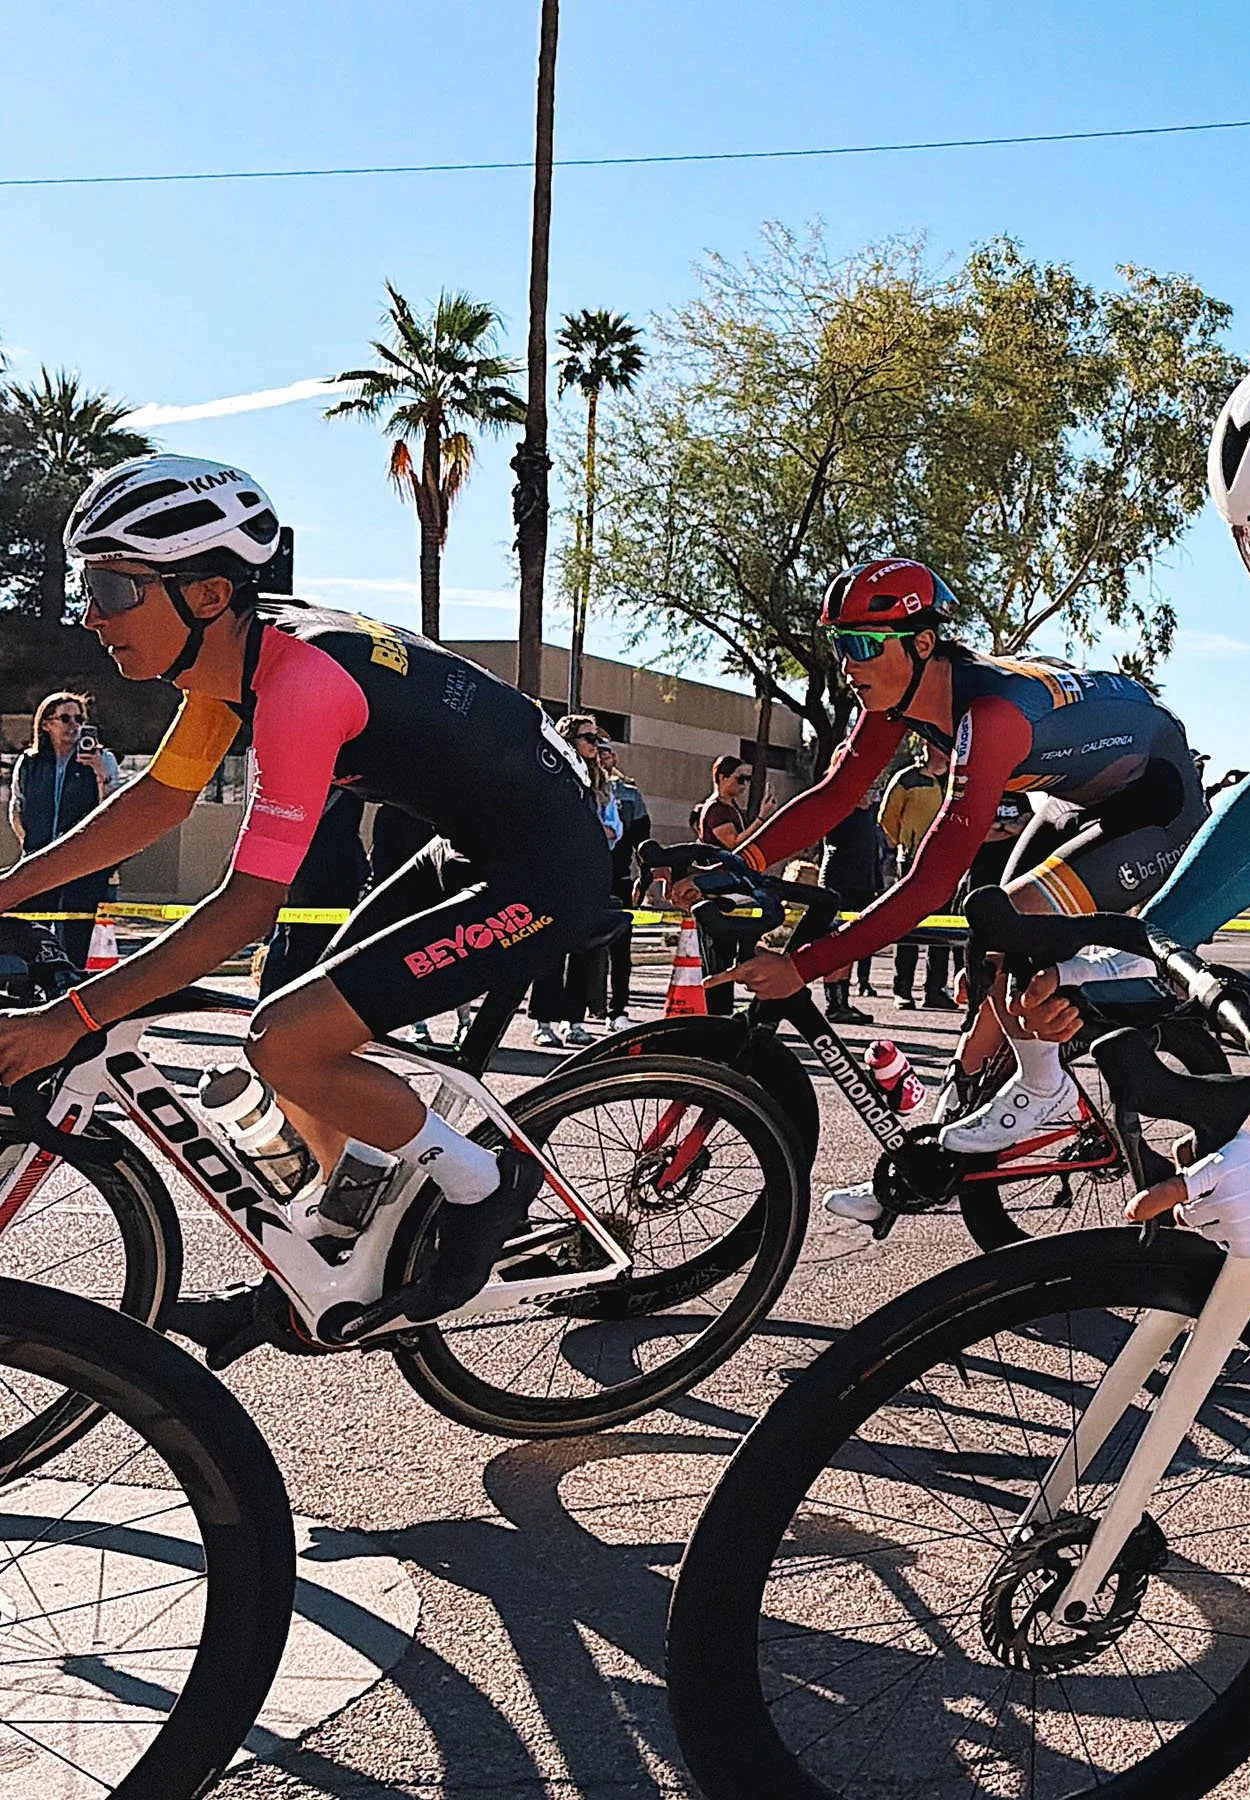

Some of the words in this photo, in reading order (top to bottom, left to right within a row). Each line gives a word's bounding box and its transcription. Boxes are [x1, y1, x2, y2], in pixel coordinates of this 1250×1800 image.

[188, 470, 244, 495] KASK
[866, 560, 916, 583] TREK
[1040, 747, 1074, 761] TEAM
[1080, 735, 1134, 755] CALIFORNIA
[403, 903, 534, 980] BEYOND
[500, 914, 555, 949] RACING
[812, 1033, 905, 1151] cannondale
[105, 1051, 293, 1246] LOOK
